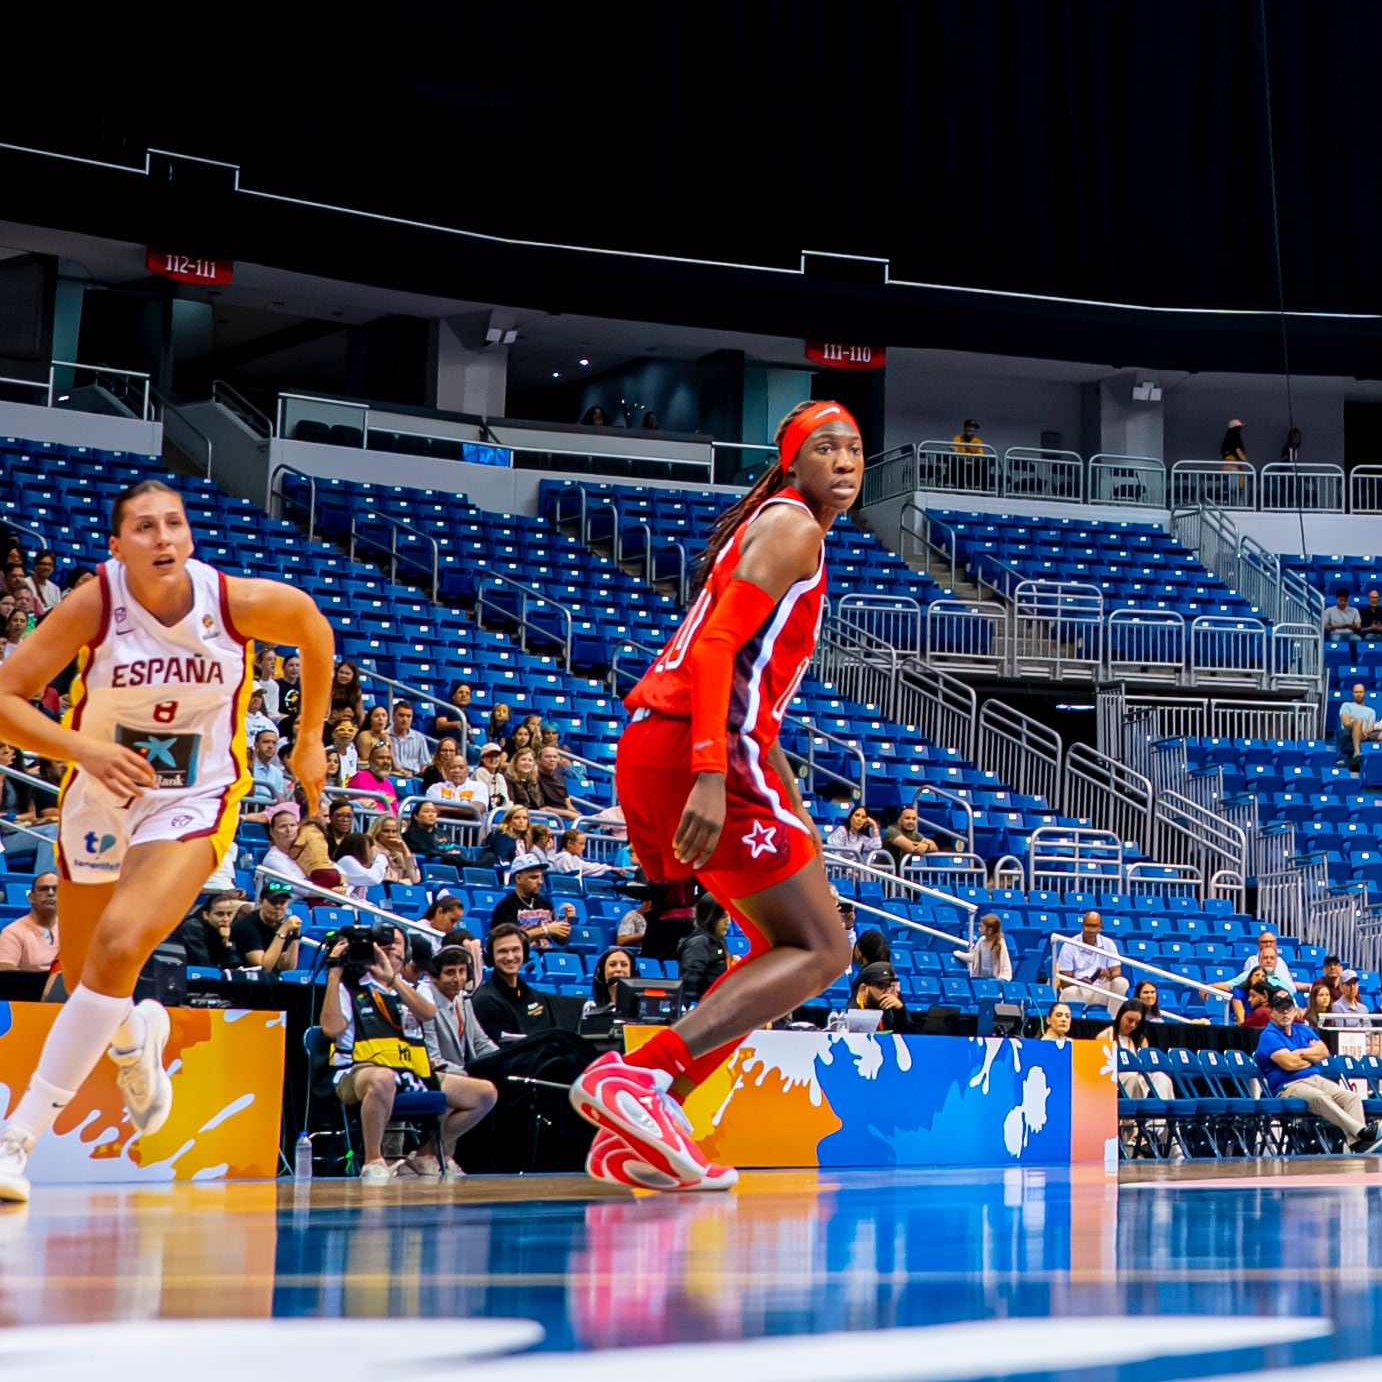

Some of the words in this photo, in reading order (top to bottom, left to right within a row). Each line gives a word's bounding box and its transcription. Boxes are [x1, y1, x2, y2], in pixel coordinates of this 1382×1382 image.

[165, 254, 216, 279] 112-111
[823, 343, 871, 363] 111-110
[111, 653, 224, 688] ESPAÑA
[153, 701, 178, 723] 8
